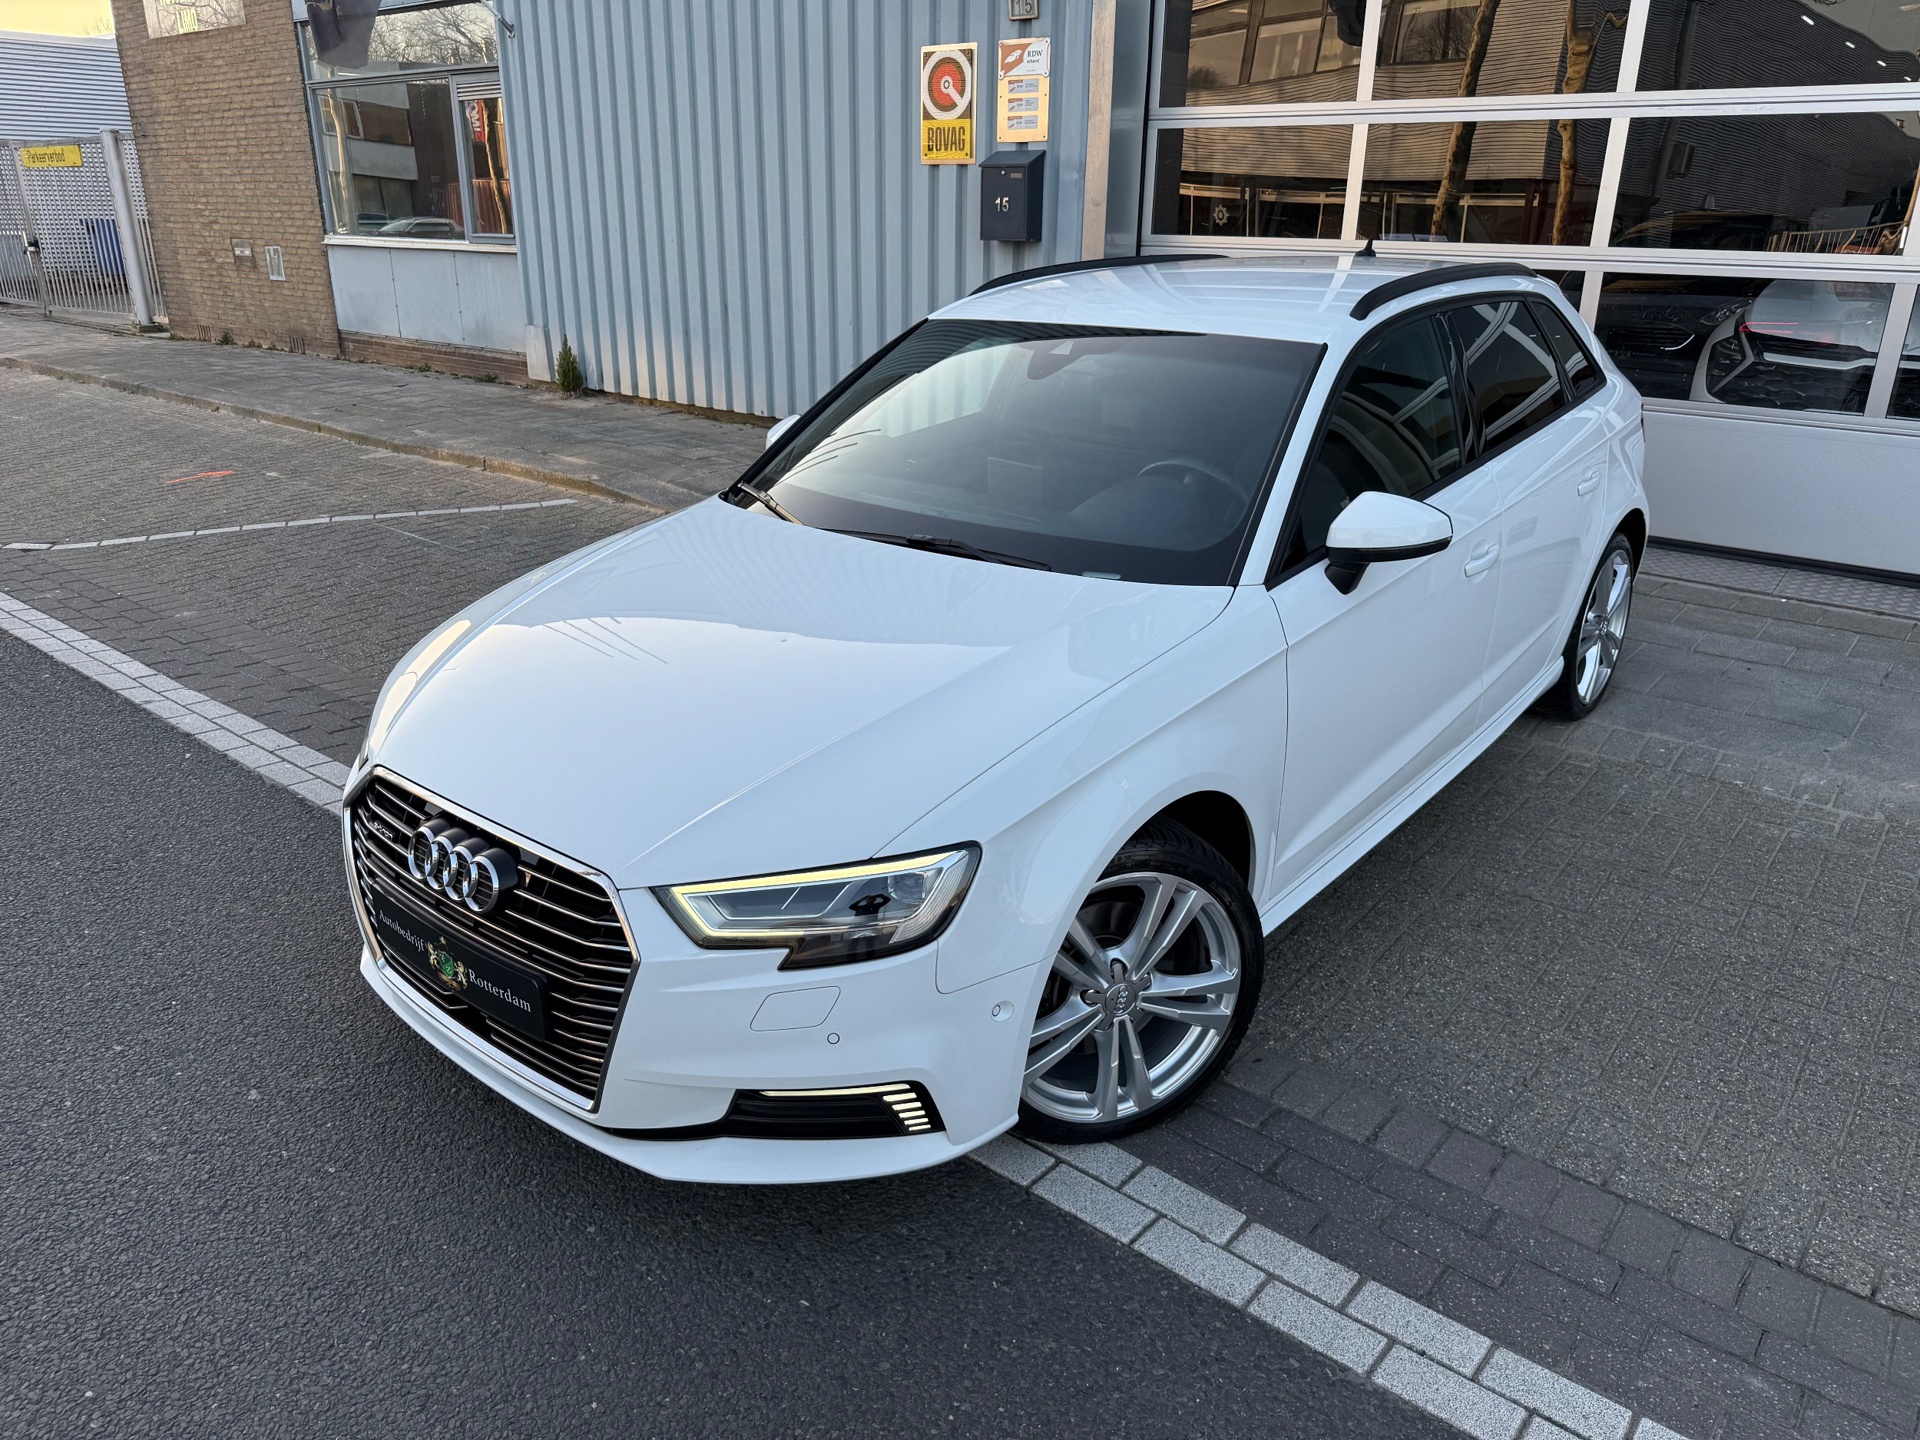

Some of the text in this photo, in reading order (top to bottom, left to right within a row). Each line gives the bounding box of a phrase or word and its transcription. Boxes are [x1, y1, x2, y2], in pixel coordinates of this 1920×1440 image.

[1027, 50, 1043, 58] RDW
[927, 126, 966, 152] BOVAG
[26, 148, 65, 163] Parkeerverbod
[995, 197, 1009, 212] 15
[267, 247, 281, 276] 17
[379, 910, 532, 1013] Autobedrijf Rotterdam
